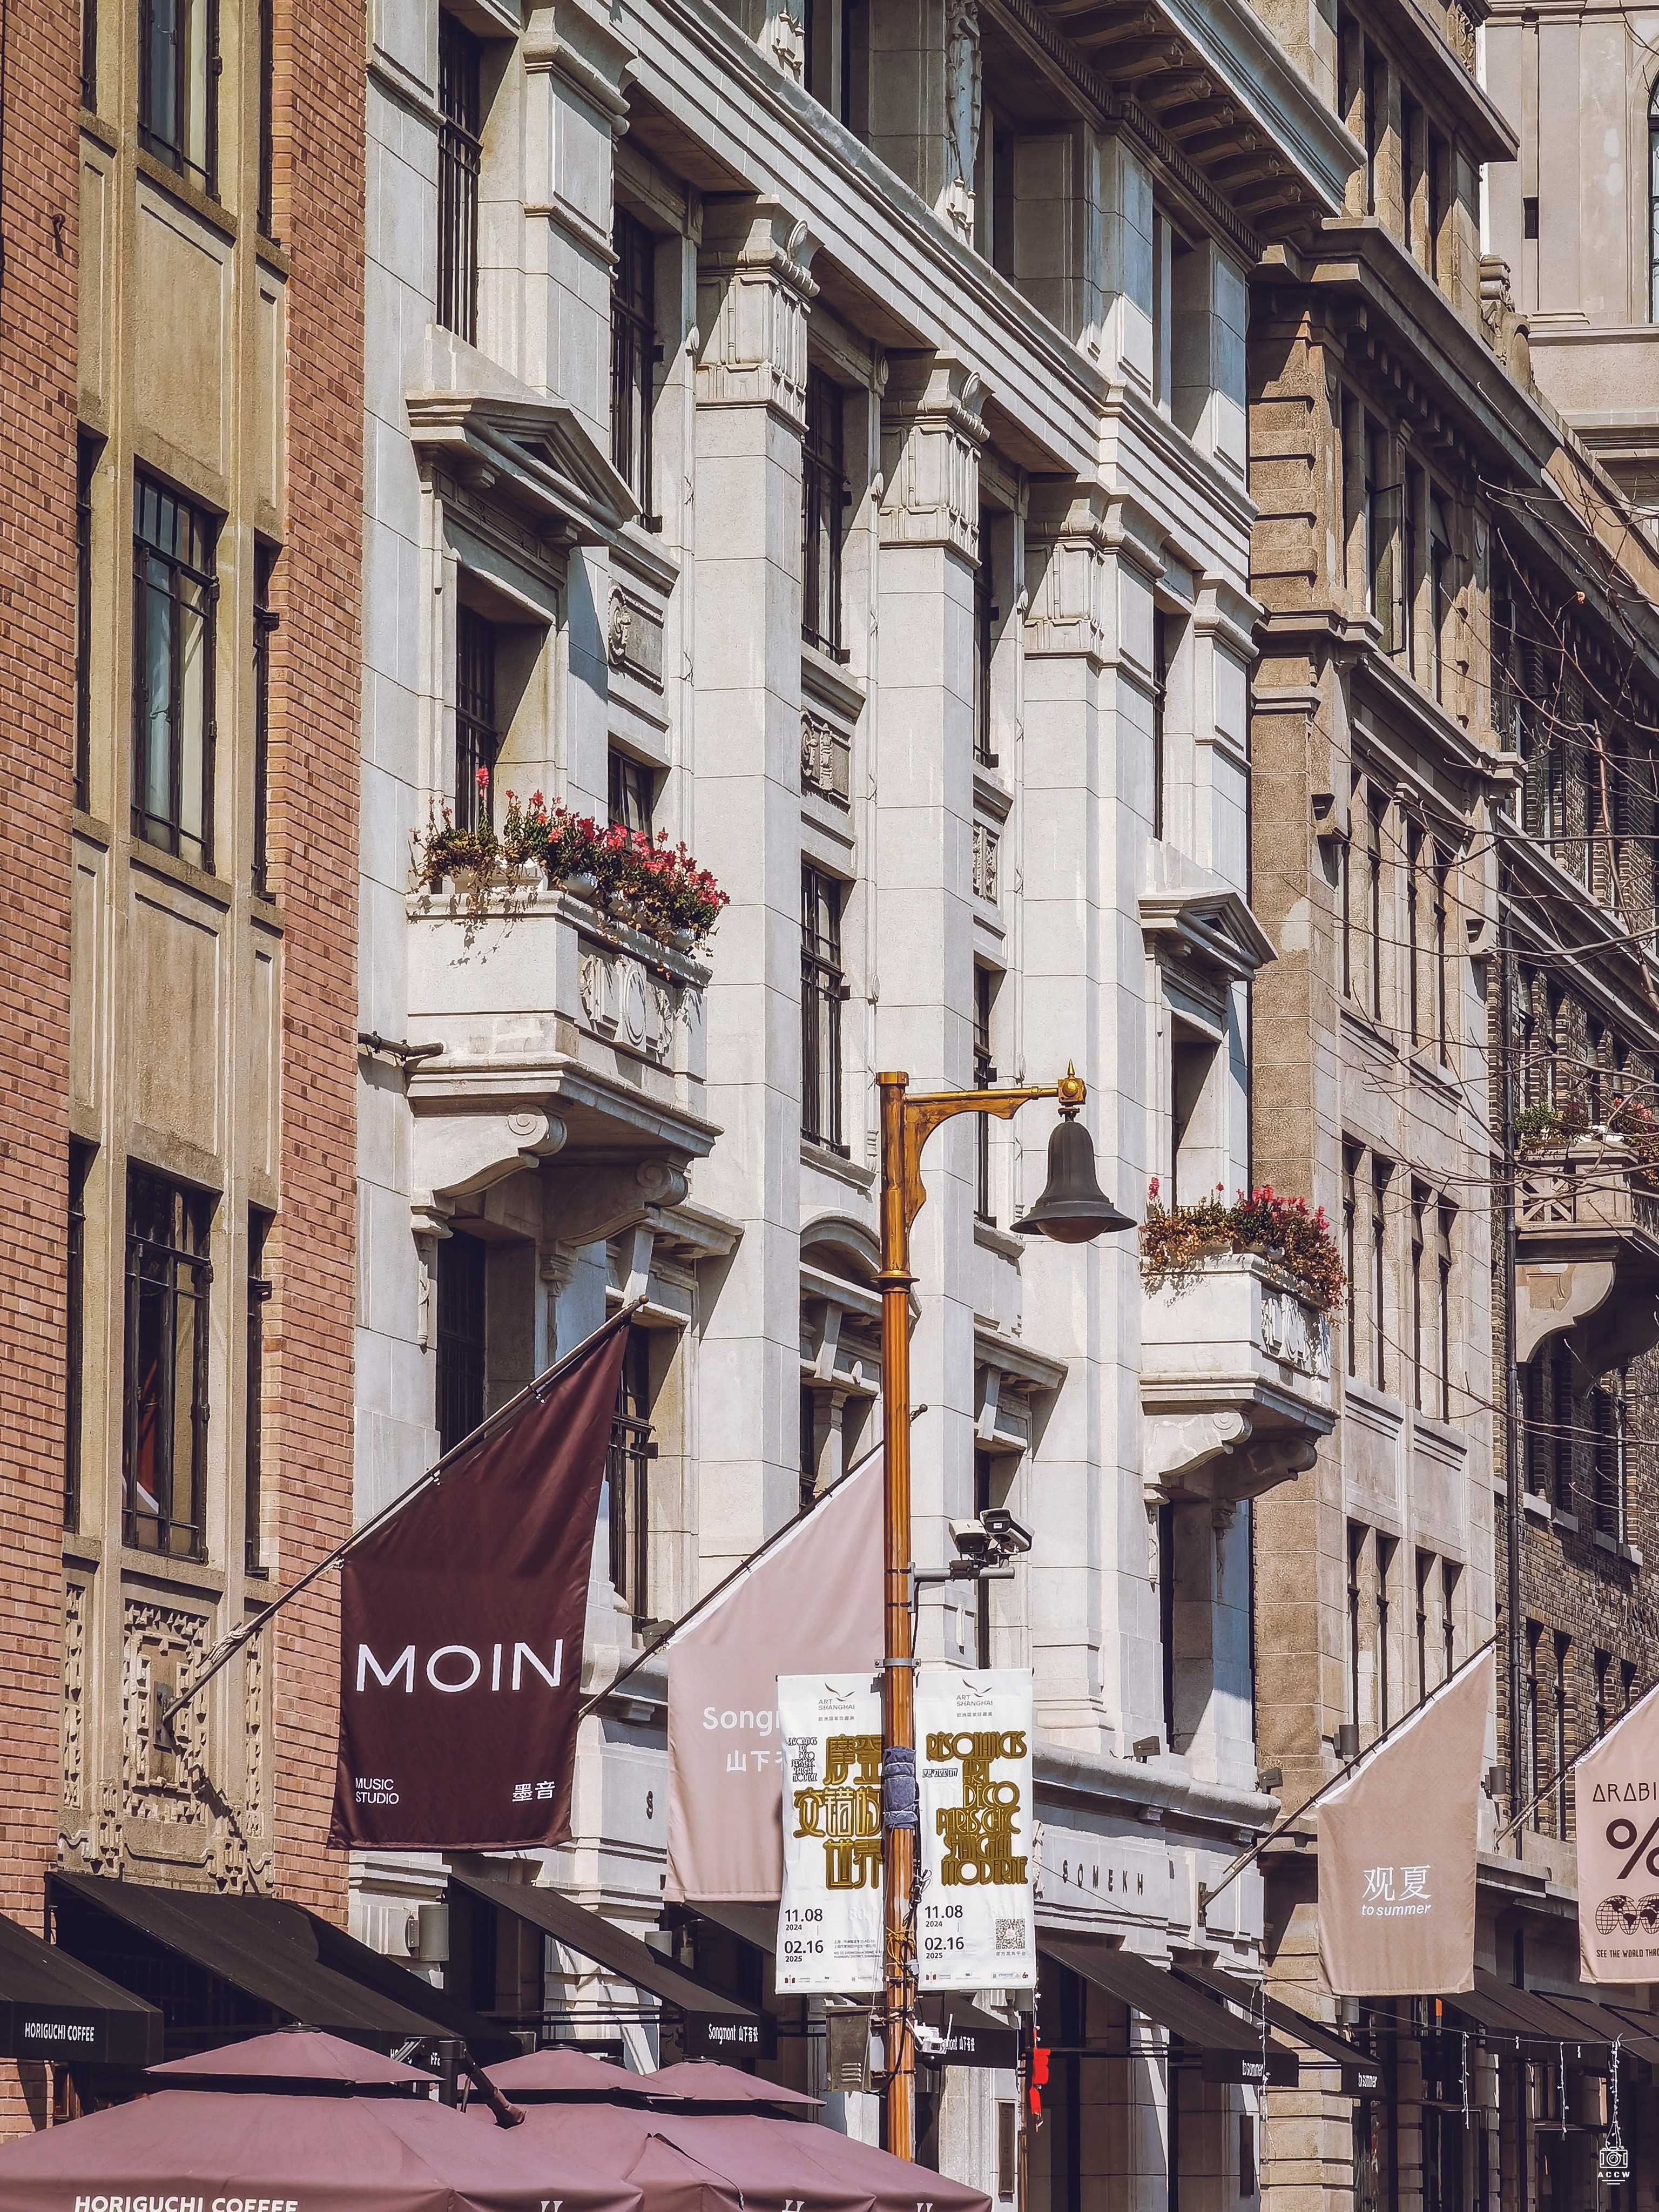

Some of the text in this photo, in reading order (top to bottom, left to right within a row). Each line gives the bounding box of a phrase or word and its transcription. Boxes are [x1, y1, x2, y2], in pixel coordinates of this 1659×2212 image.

[356, 1638, 563, 1693] MOIN
[703, 1707, 780, 1736] Song
[355, 1777, 394, 1791] MUSIC
[355, 1792, 399, 1804] STUDIO
[512, 1781, 555, 1802] 墨音
[1362, 1865, 1432, 1901] 观夏
[785, 1908, 823, 1922] 11.08
[925, 1905, 963, 1919] 11.08
[1362, 1904, 1432, 1916] to summer
[784, 1940, 824, 1954] 02.16
[925, 1937, 964, 1951] 02.16
[1596, 1950, 1607, 1958] SEE
[1609, 1950, 1621, 1958] THE
[1622, 1949, 1643, 1958] WORLD
[25, 2022, 95, 2041] HORIGUCHI COFFEE
[709, 2023, 736, 2045] Songmont
[74, 2196, 204, 2212] HORIGUCHI
